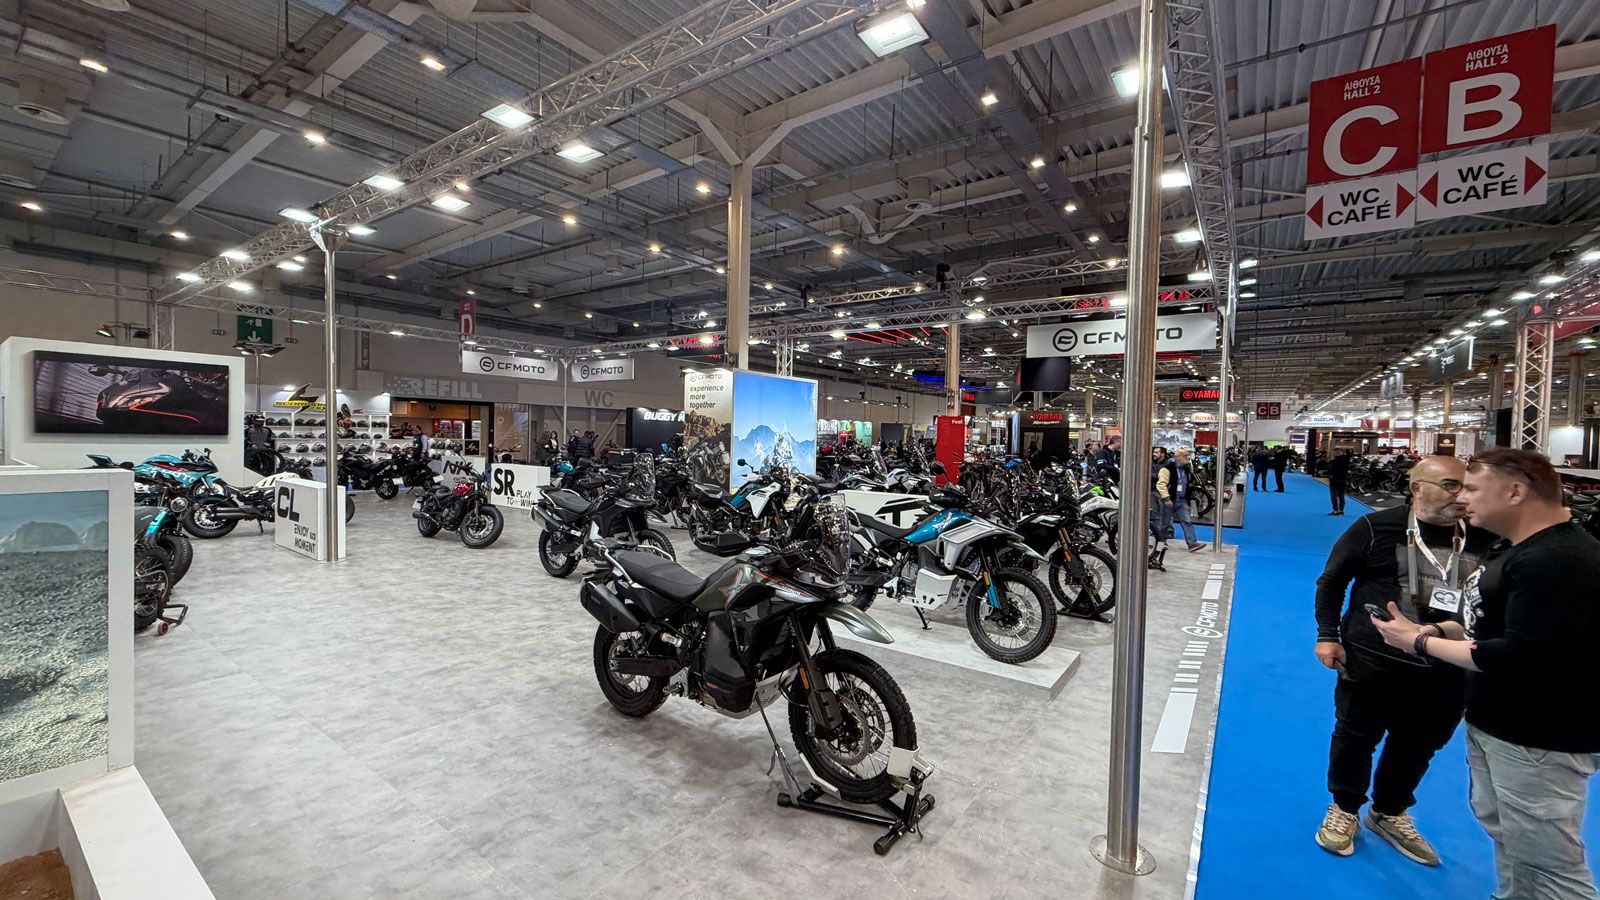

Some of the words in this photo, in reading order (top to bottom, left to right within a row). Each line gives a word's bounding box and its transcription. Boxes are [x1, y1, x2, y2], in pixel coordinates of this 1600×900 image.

[1466, 44, 1509, 62] ΑΙΘΟΥΣΑ
[1465, 56, 1497, 72] HALL
[1500, 54, 1509, 64] 2
[1344, 75, 1381, 91] ΑΙΘΟΥΣΑ
[1343, 87, 1370, 101] HALL
[1373, 84, 1381, 95] 2
[1446, 72, 1523, 146] B
[1323, 104, 1399, 177] C
[1457, 162, 1506, 184] WC
[1339, 187, 1381, 207] WC
[1442, 175, 1518, 205] CAFÉ
[1326, 200, 1391, 226] CAFÉ
[497, 361, 546, 375] CFMOTO
[590, 365, 624, 376] CFMOTO
[410, 378, 482, 399] REFILL
[689, 384, 724, 393] experience
[584, 390, 614, 407] WC
[689, 401, 716, 410] together
[643, 411, 677, 421] BUGGY
[1258, 407, 1267, 415] C
[1270, 407, 1279, 415] B
[493, 467, 515, 496] SR
[506, 496, 515, 504] TO
[516, 489, 532, 499] PLAY
[277, 486, 300, 522] CL
[294, 537, 316, 555] MOMENT
